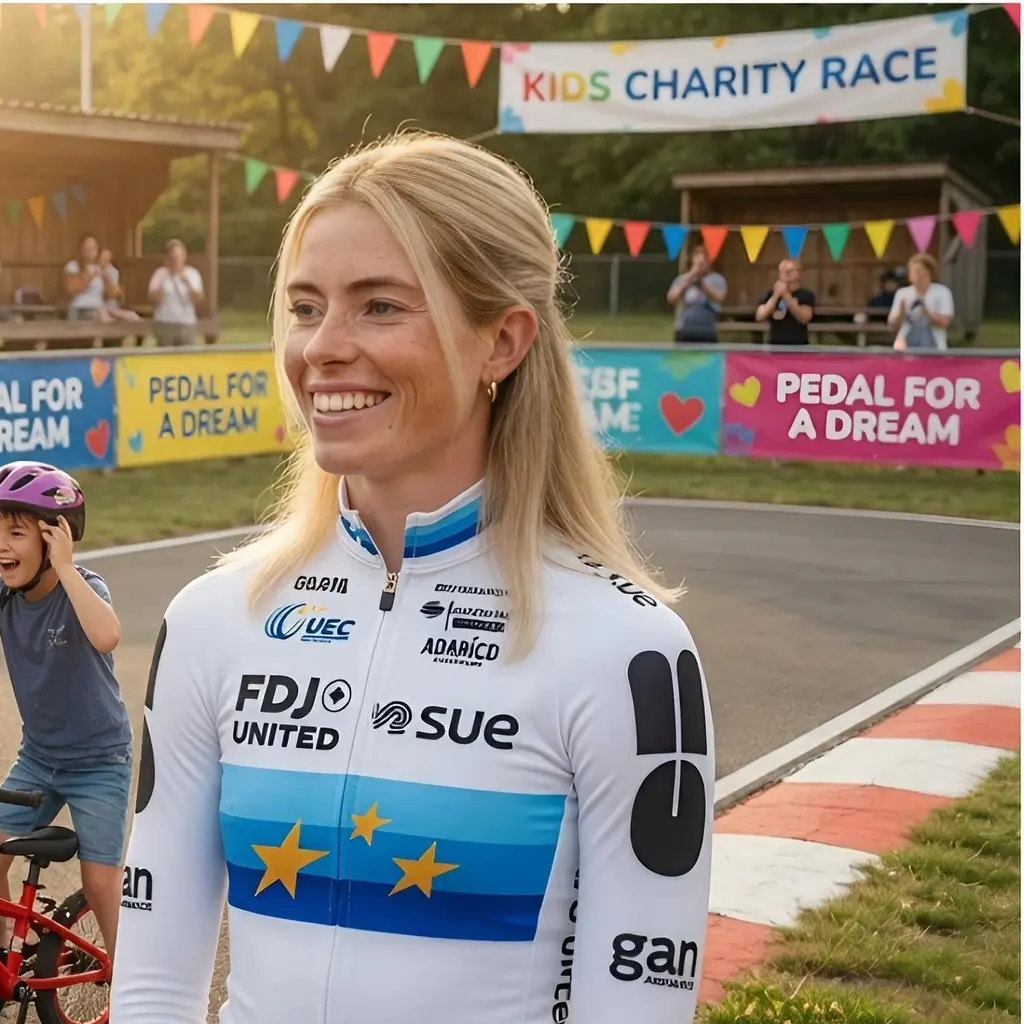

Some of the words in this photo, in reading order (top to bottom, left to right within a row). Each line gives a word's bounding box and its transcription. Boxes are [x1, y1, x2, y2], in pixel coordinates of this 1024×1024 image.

[523, 70, 611, 103] KIDS
[625, 59, 806, 101] CHARITY
[821, 46, 938, 90] RACE
[31, 377, 84, 412] FOR
[149, 374, 220, 404] PEDAL
[227, 370, 270, 399] FOR
[776, 371, 895, 408] PEDAL
[904, 375, 981, 411] FOR
[158, 412, 176, 440] A
[181, 407, 258, 437] DREAM
[787, 407, 817, 441] A
[826, 409, 960, 447] DREAM
[305, 617, 356, 636] UEC
[235, 674, 321, 720] FDJ
[232, 720, 340, 751] UNITED
[415, 705, 520, 750] sue
[609, 933, 698, 982] gan
